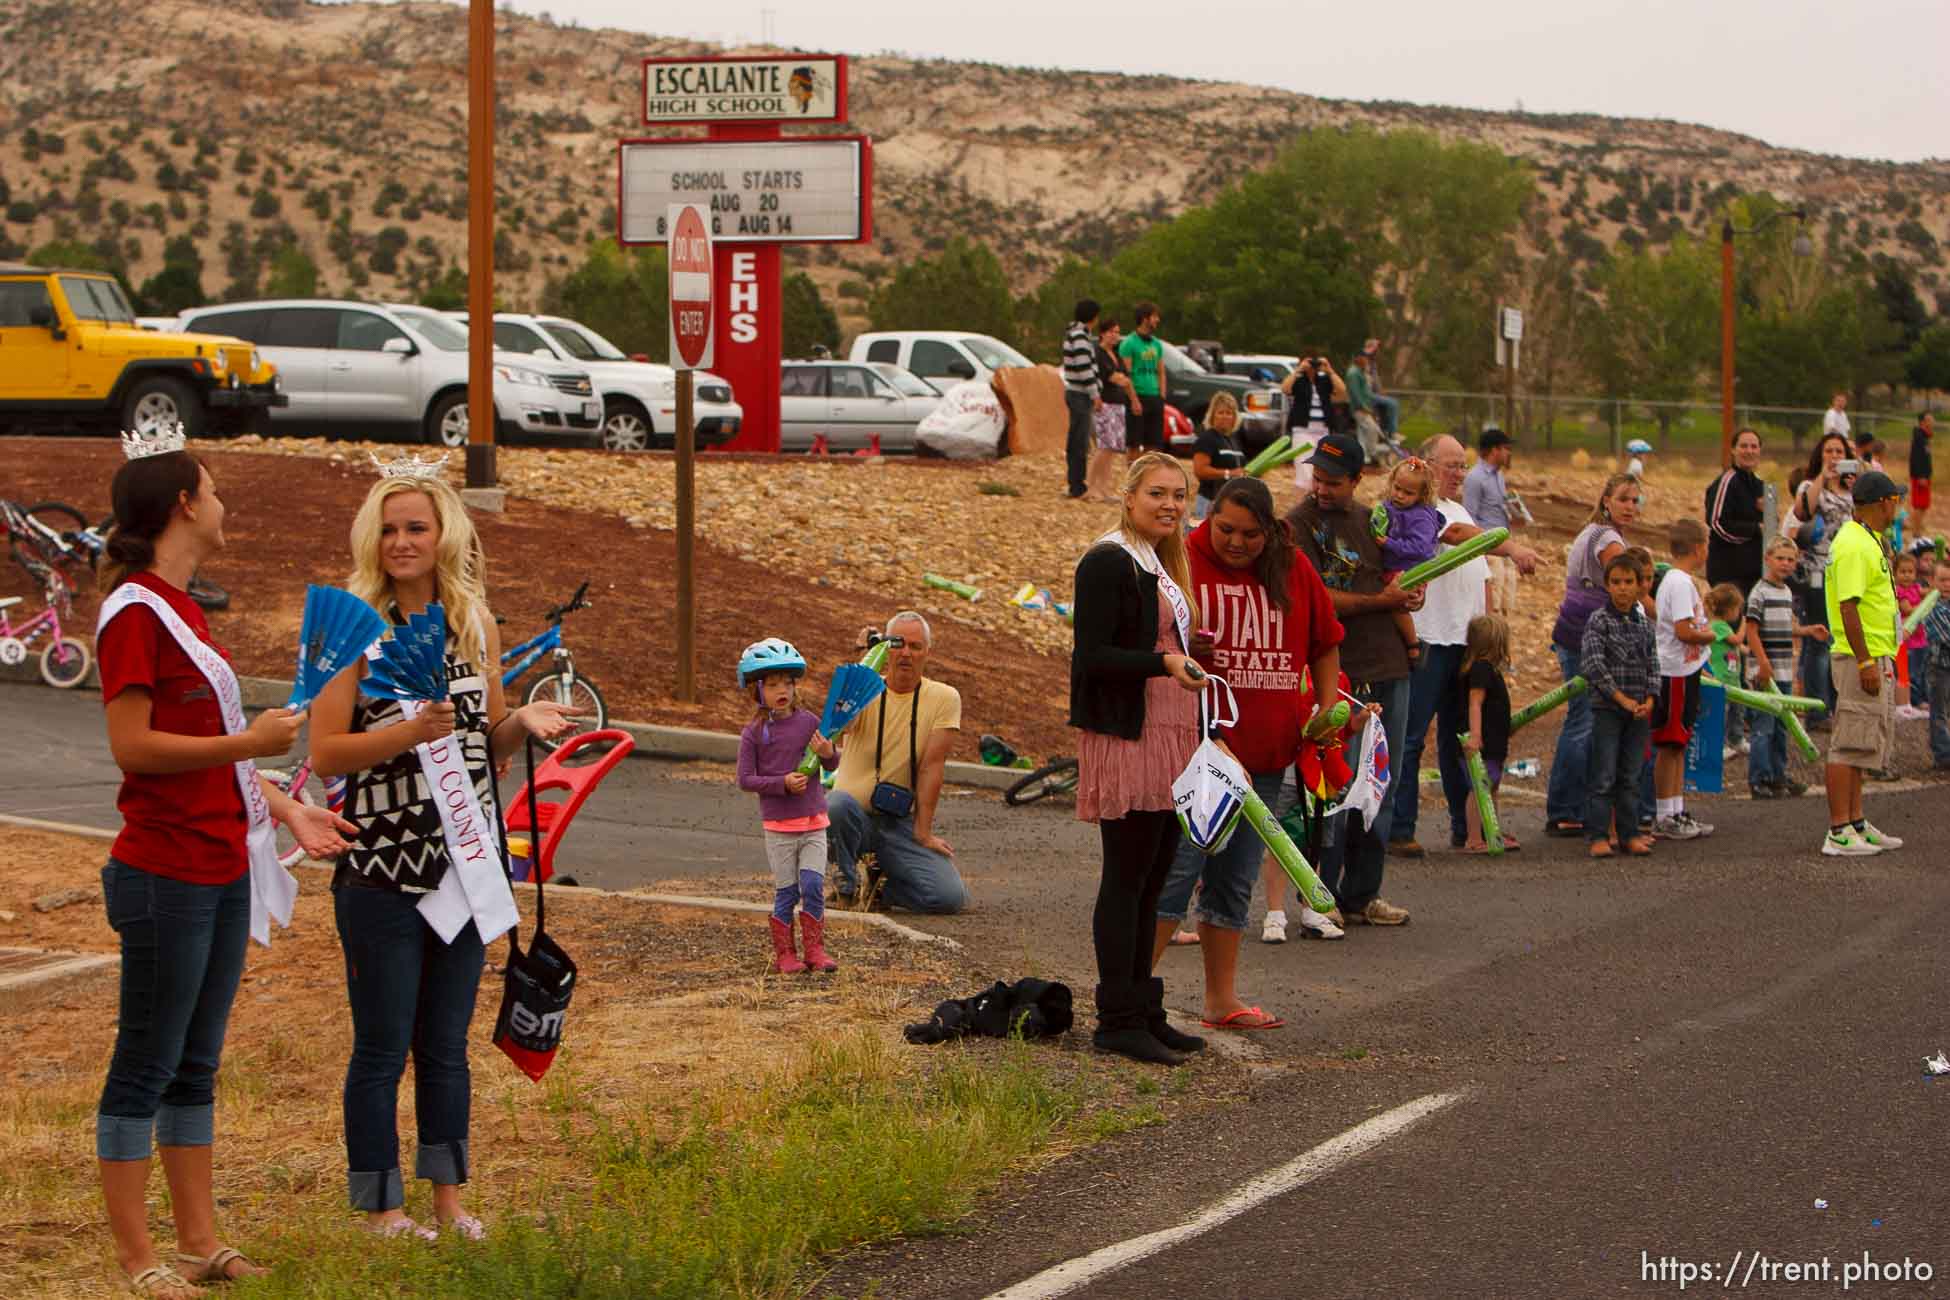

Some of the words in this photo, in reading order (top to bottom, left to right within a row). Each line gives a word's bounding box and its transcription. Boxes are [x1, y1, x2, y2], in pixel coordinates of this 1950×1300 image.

[655, 66, 781, 95] ESCALANTE
[650, 99, 696, 113] HIGH
[706, 97, 785, 113] SCHOOL
[671, 172, 727, 190] SCHOOL
[742, 171, 803, 190] STARTS
[710, 194, 740, 212] AUG
[759, 194, 779, 211] 20
[738, 217, 770, 235] AUG
[777, 216, 792, 233] 14
[730, 253, 758, 343] EHS
[680, 311, 704, 336] ENTER
[1200, 583, 1284, 649] UTAH
[1213, 649, 1292, 671] STATE
[1227, 669, 1299, 690] CHAMPIONSHIPS
[439, 770, 487, 862] COUNTY
